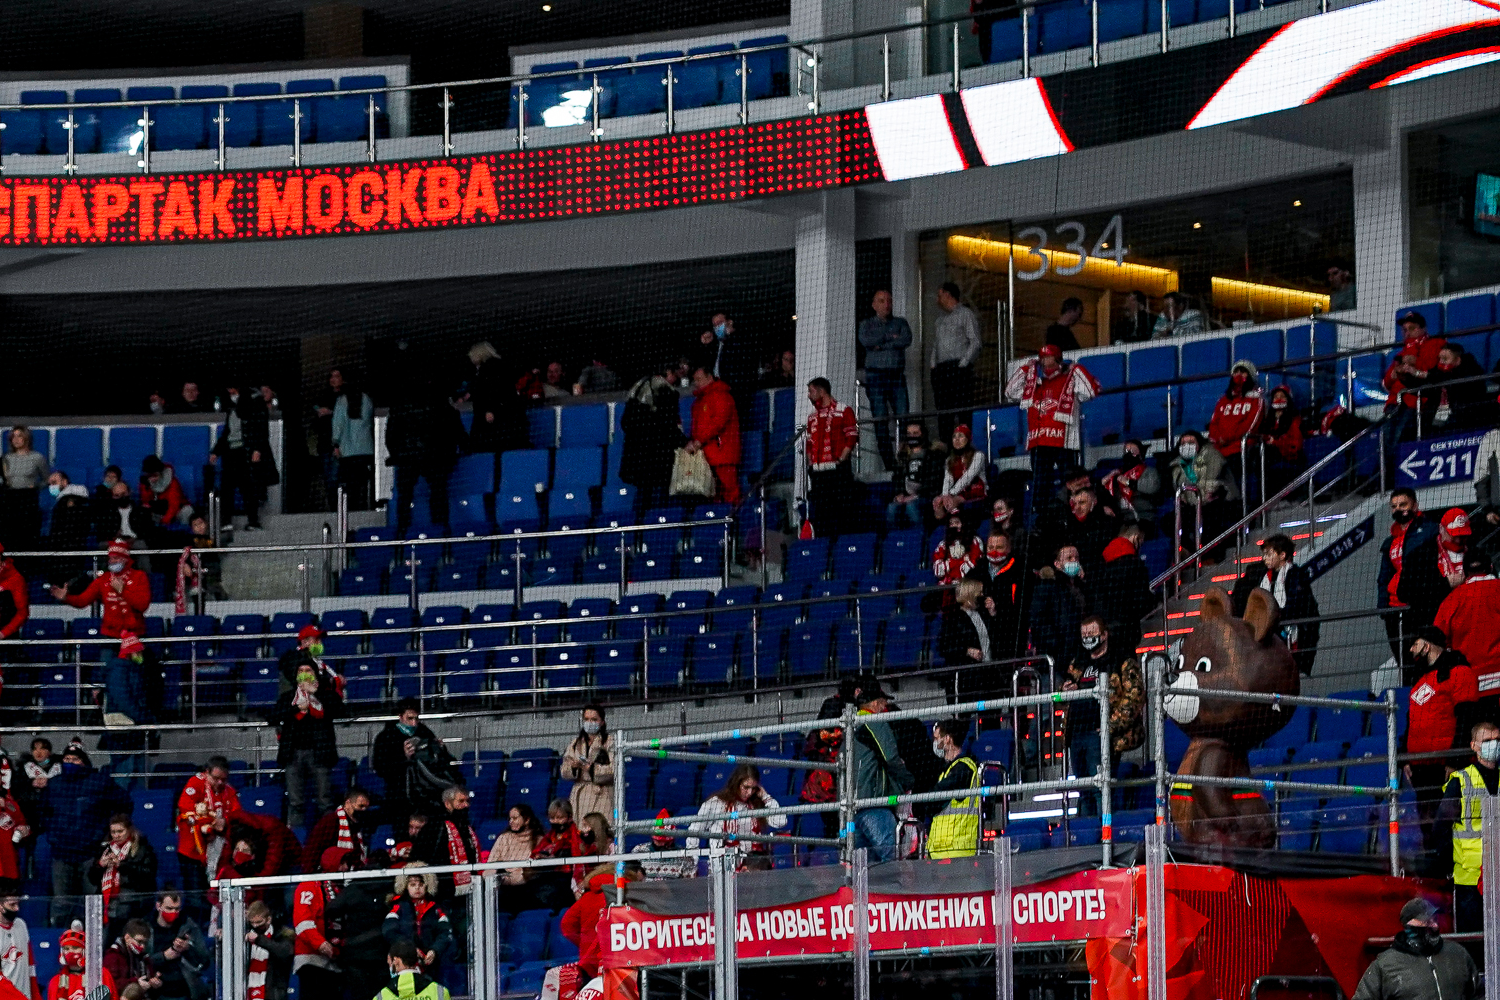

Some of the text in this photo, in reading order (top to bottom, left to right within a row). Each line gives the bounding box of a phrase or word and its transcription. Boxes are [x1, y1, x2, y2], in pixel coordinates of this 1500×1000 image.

[257, 163, 501, 238] МОСКВА
[1016, 214, 1129, 281] 334
[1429, 450, 1472, 481] 211
[300, 891, 314, 905] 12
[756, 906, 827, 940] НОВЫЕ
[830, 896, 985, 941] ДОСТИЖЕНИЯ
[1013, 888, 1106, 925] СПОРТЕ!
